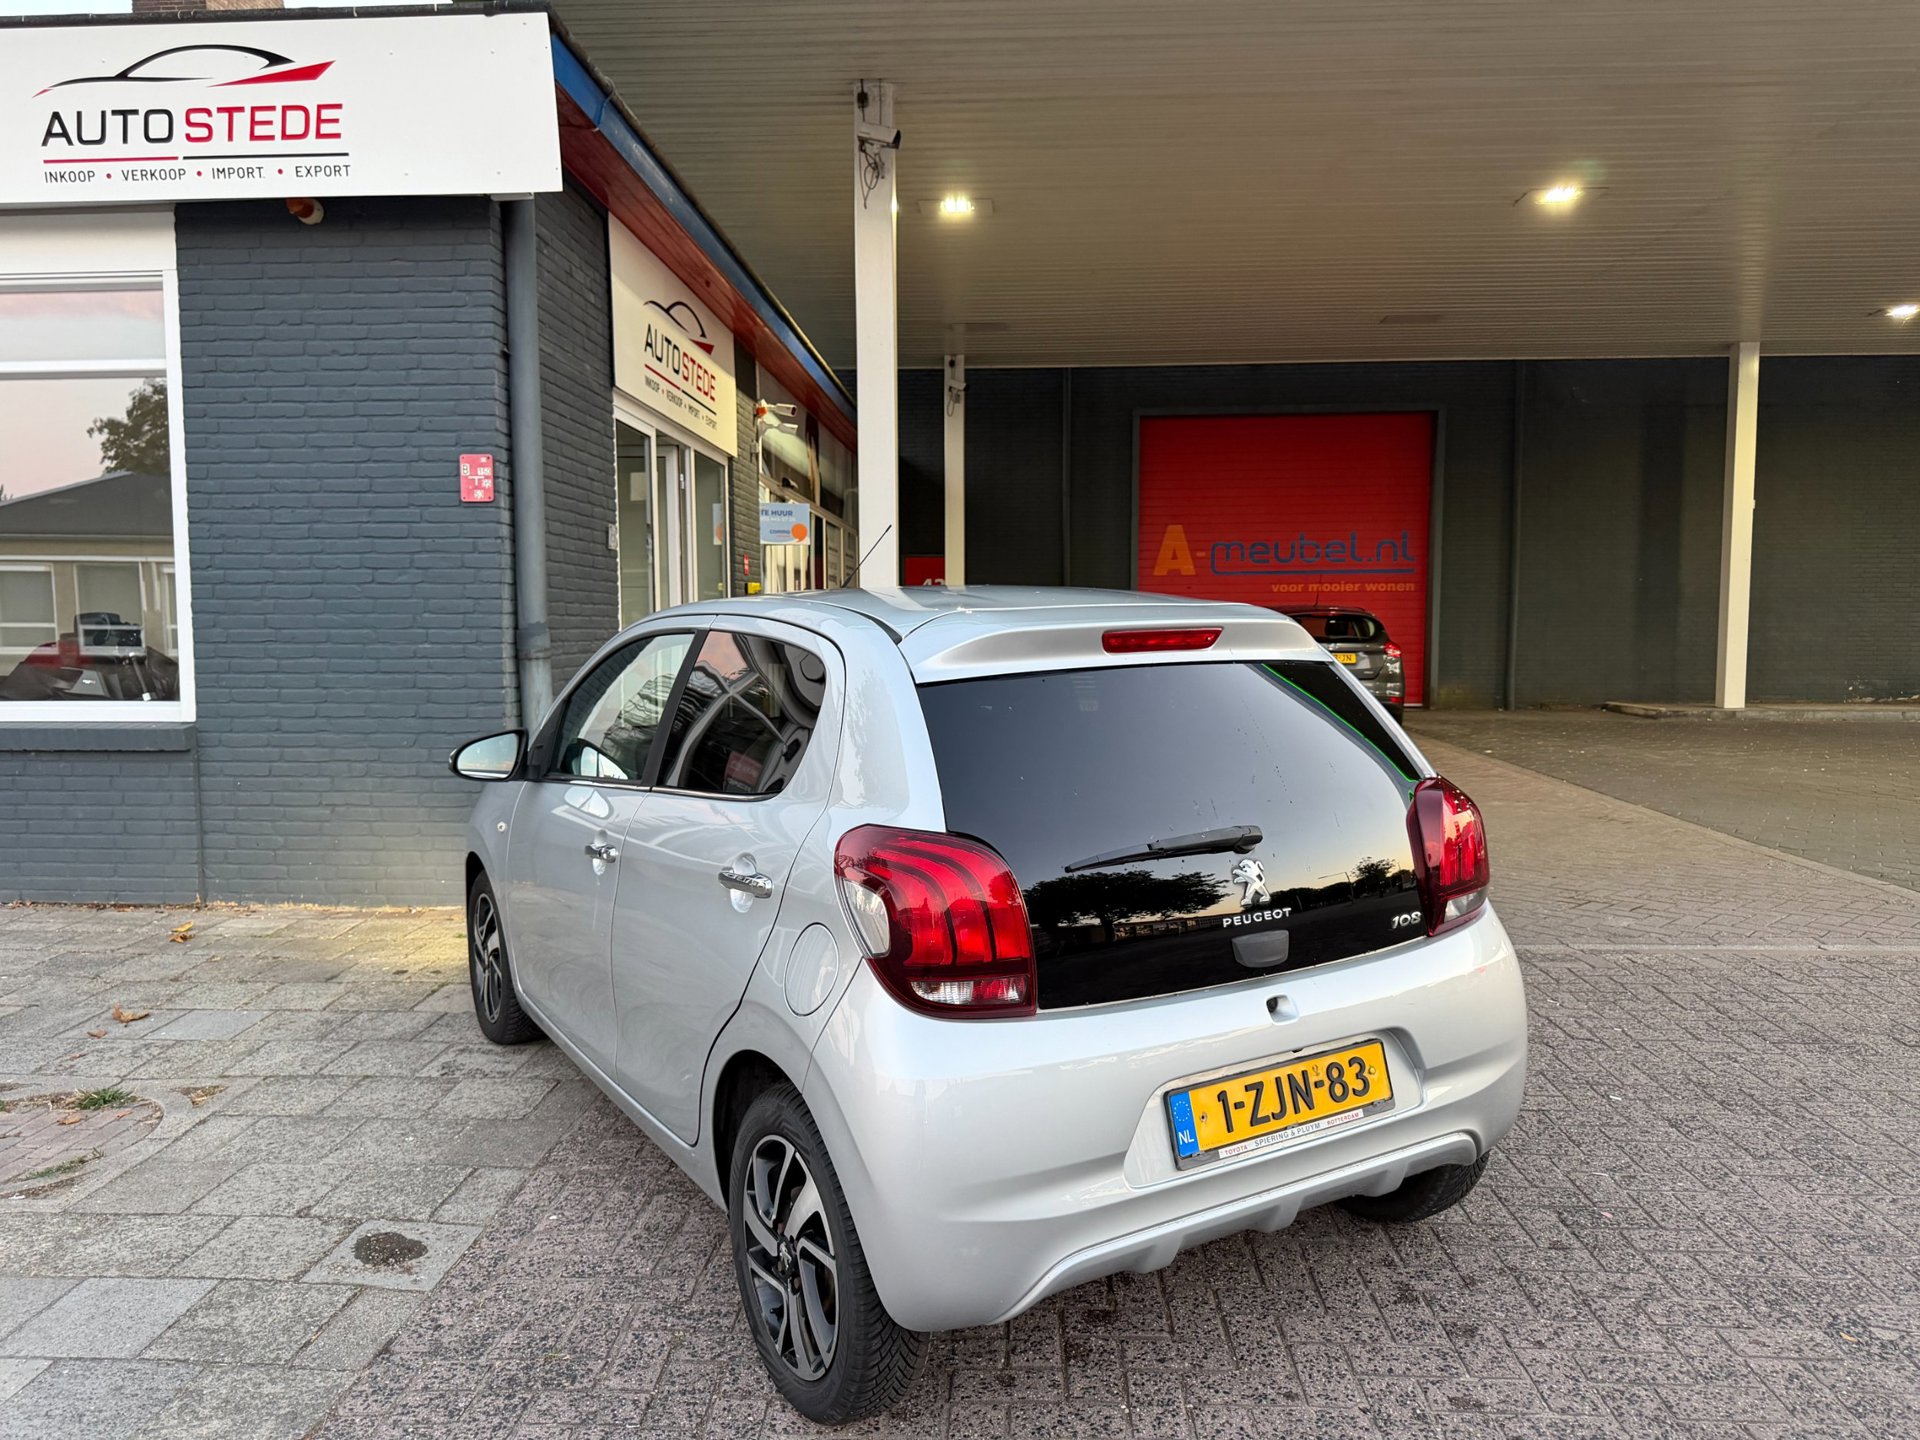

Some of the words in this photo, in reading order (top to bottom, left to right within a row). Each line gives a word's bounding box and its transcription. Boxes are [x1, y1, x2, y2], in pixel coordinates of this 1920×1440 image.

[44, 170, 95, 183] INKOOP
[121, 168, 186, 182] VERKOOP
[211, 166, 264, 180] IMPORT
[295, 164, 351, 178] EXPORT
[1271, 582, 1304, 593] voor
[1308, 580, 1360, 593] mooier
[1365, 582, 1415, 592] wonen
[1222, 907, 1292, 928] PEUGEOT
[1391, 911, 1422, 930] 108
[1217, 1056, 1371, 1133] 1-ZJN-83
[1178, 1129, 1195, 1146] NL
[1225, 1145, 1248, 1155] TOYOTA
[1254, 1131, 1289, 1147] SPIERING
[1296, 1122, 1321, 1135] PLUYM
[1326, 1112, 1360, 1126] ROTTERDAM
